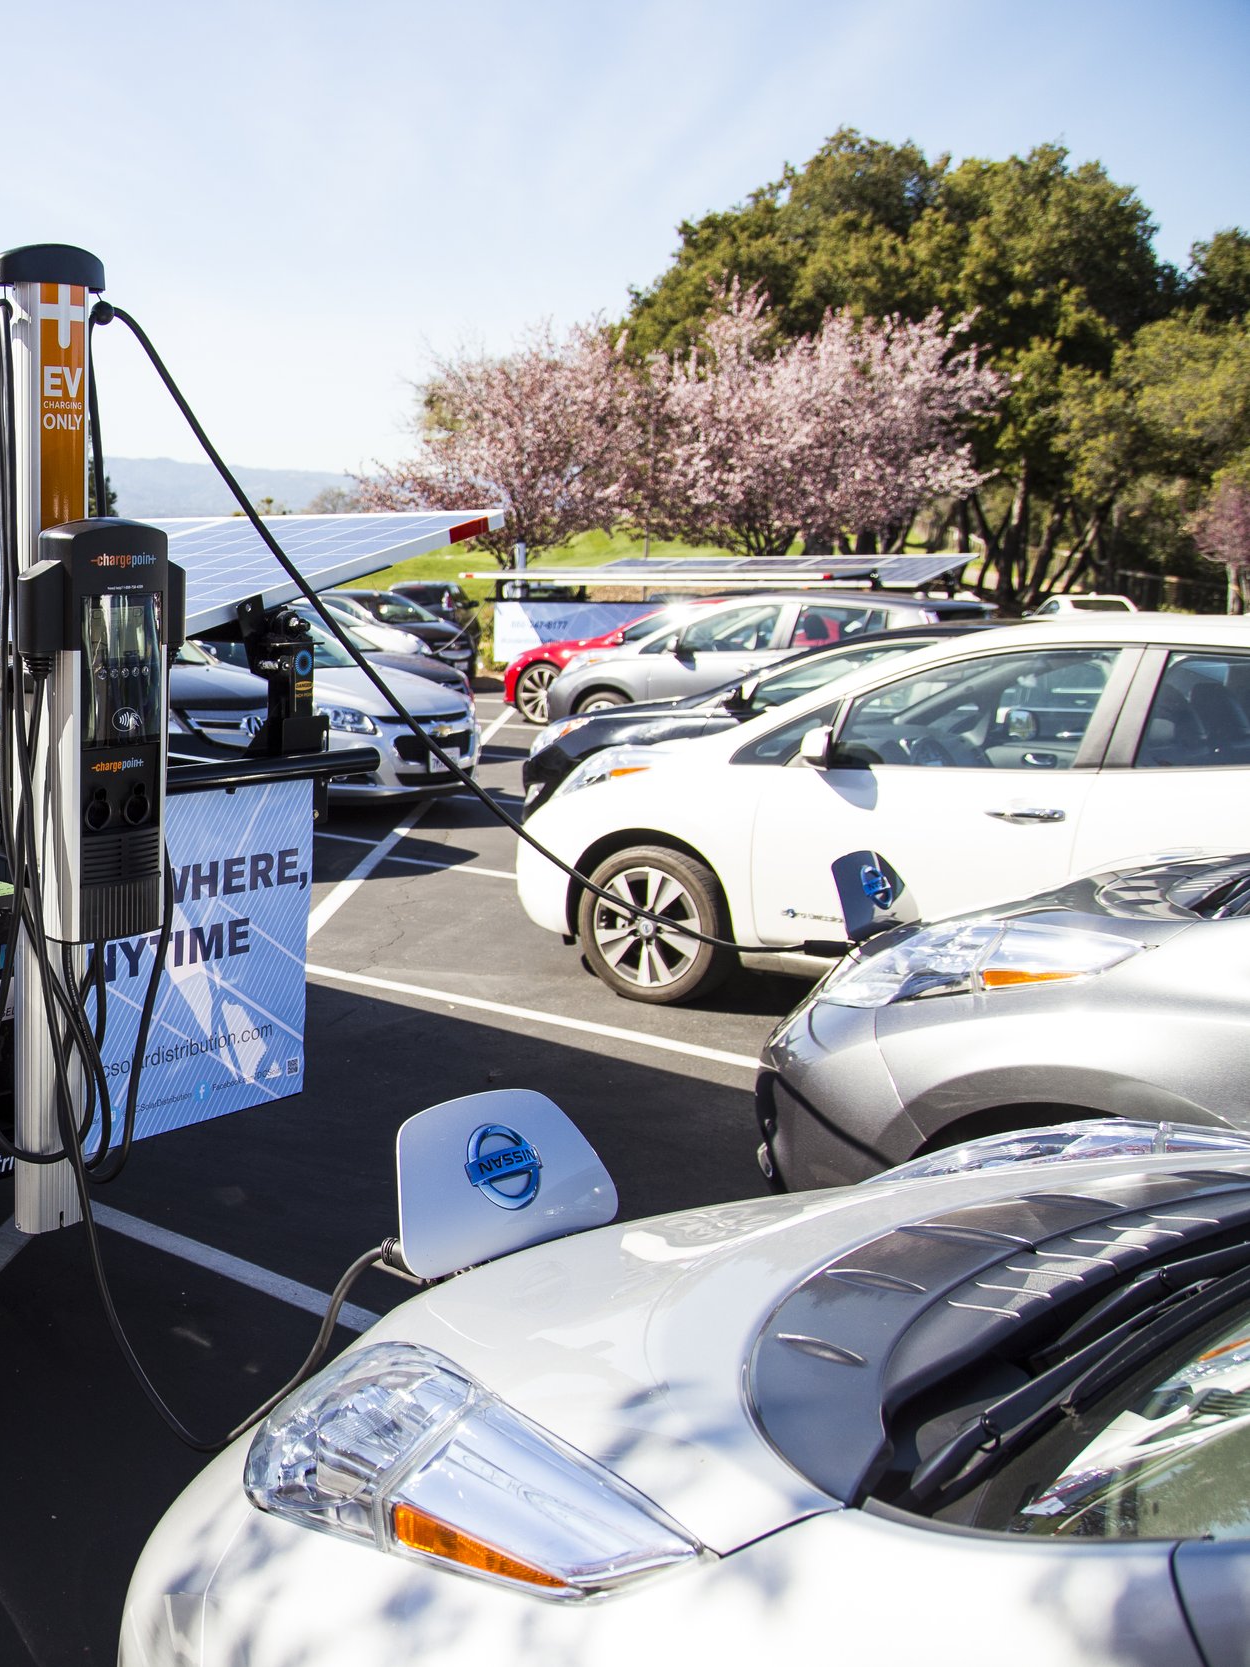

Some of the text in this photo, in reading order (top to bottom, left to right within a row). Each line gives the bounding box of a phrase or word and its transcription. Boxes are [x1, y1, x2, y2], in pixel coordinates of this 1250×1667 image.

[43, 365, 83, 398] EV
[43, 400, 82, 410] CHARGING
[43, 413, 83, 431] ONLY
[91, 551, 157, 569] chargepoint
[91, 757, 144, 773] chargepoint
[477, 1148, 537, 1175] NISSAN
